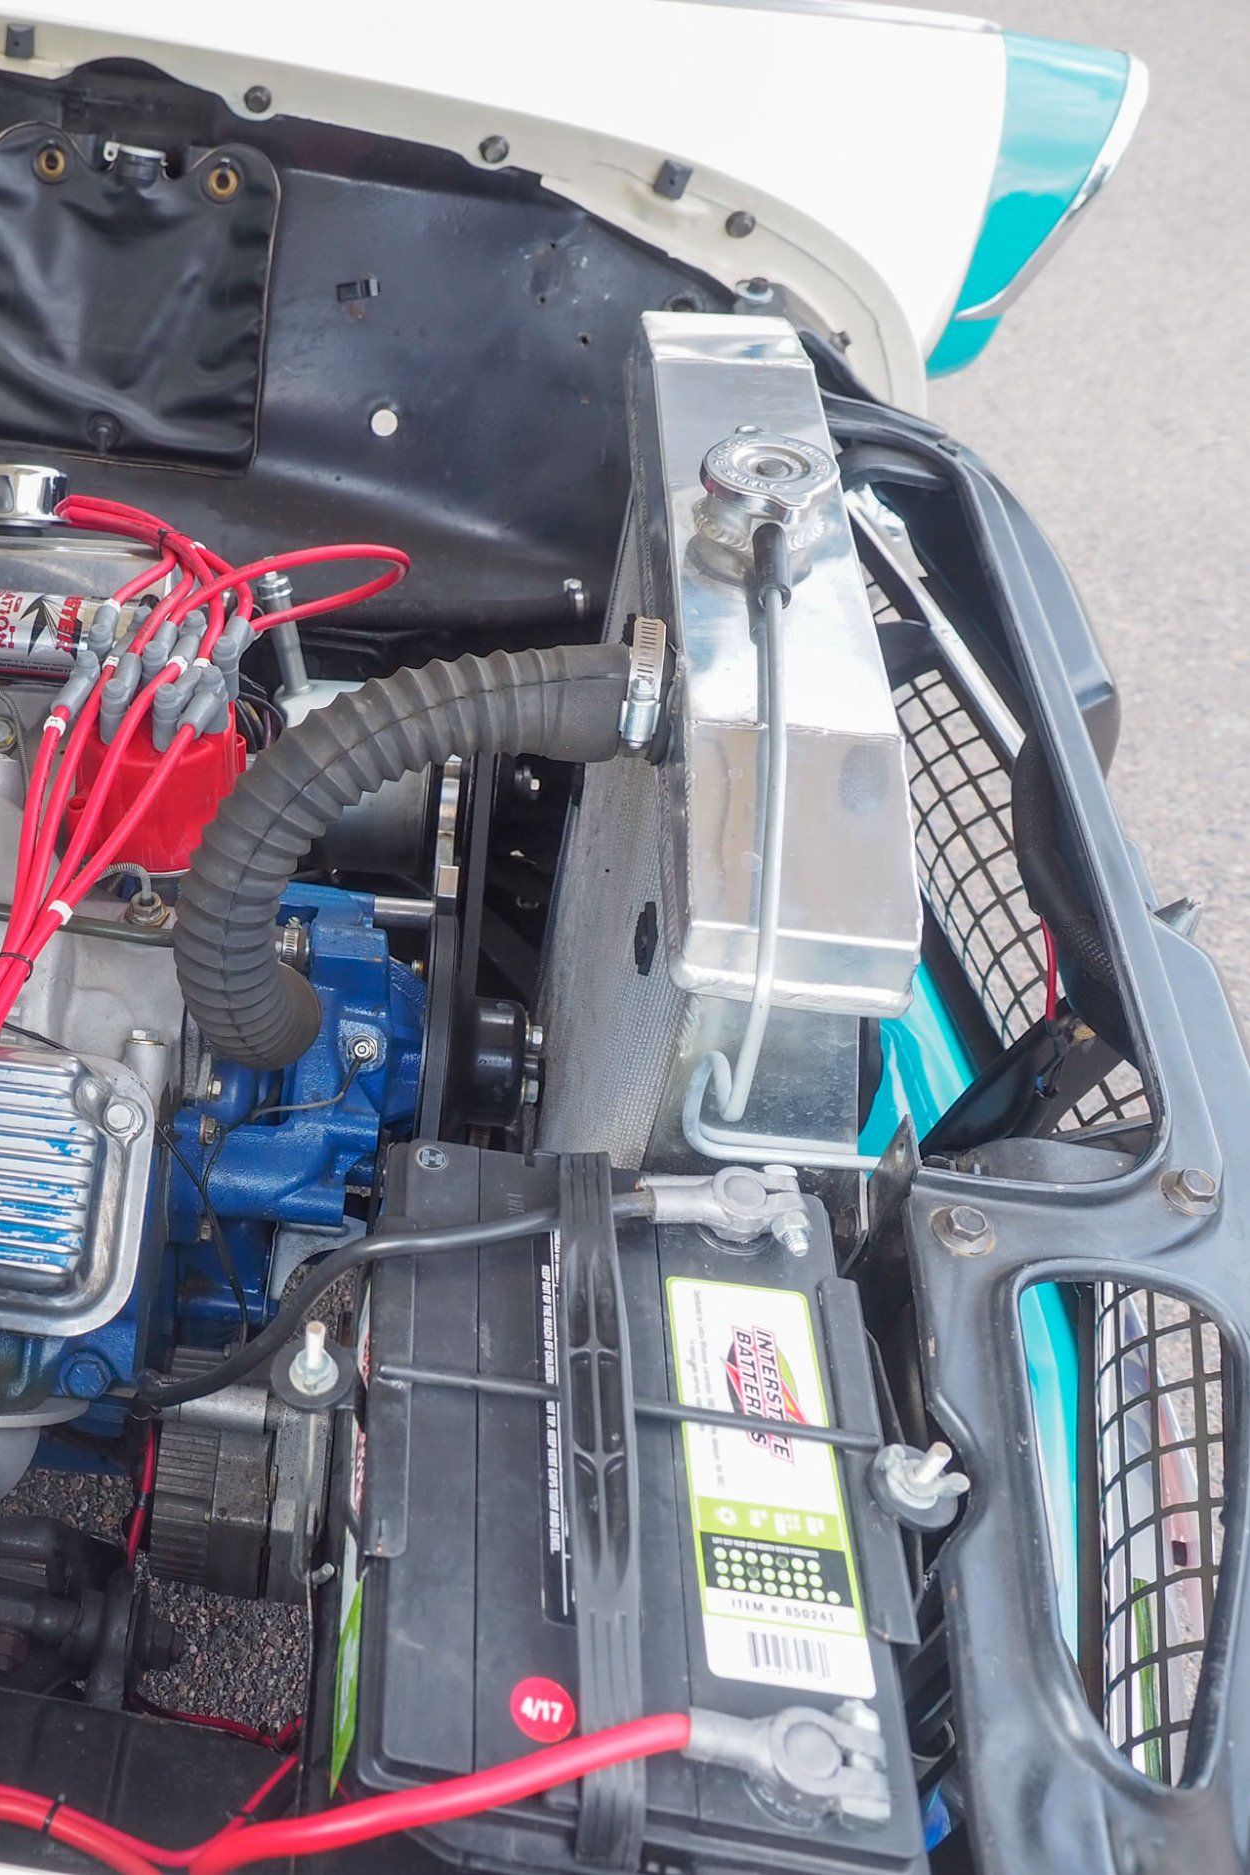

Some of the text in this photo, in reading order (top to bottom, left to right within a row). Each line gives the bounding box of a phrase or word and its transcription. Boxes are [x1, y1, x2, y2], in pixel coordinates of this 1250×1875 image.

[541, 1265, 551, 1281] KEEP
[542, 1281, 552, 1294] OUT
[543, 1295, 552, 1304] OF
[543, 1305, 553, 1317] THE
[543, 1317, 553, 1340] REACH
[544, 1340, 553, 1350] OF
[736, 1330, 767, 1444] BATTERIS
[756, 1329, 791, 1459] INTERSTTE
[731, 1599, 765, 1612] ITEM
[520, 1696, 564, 1725] 4/17
